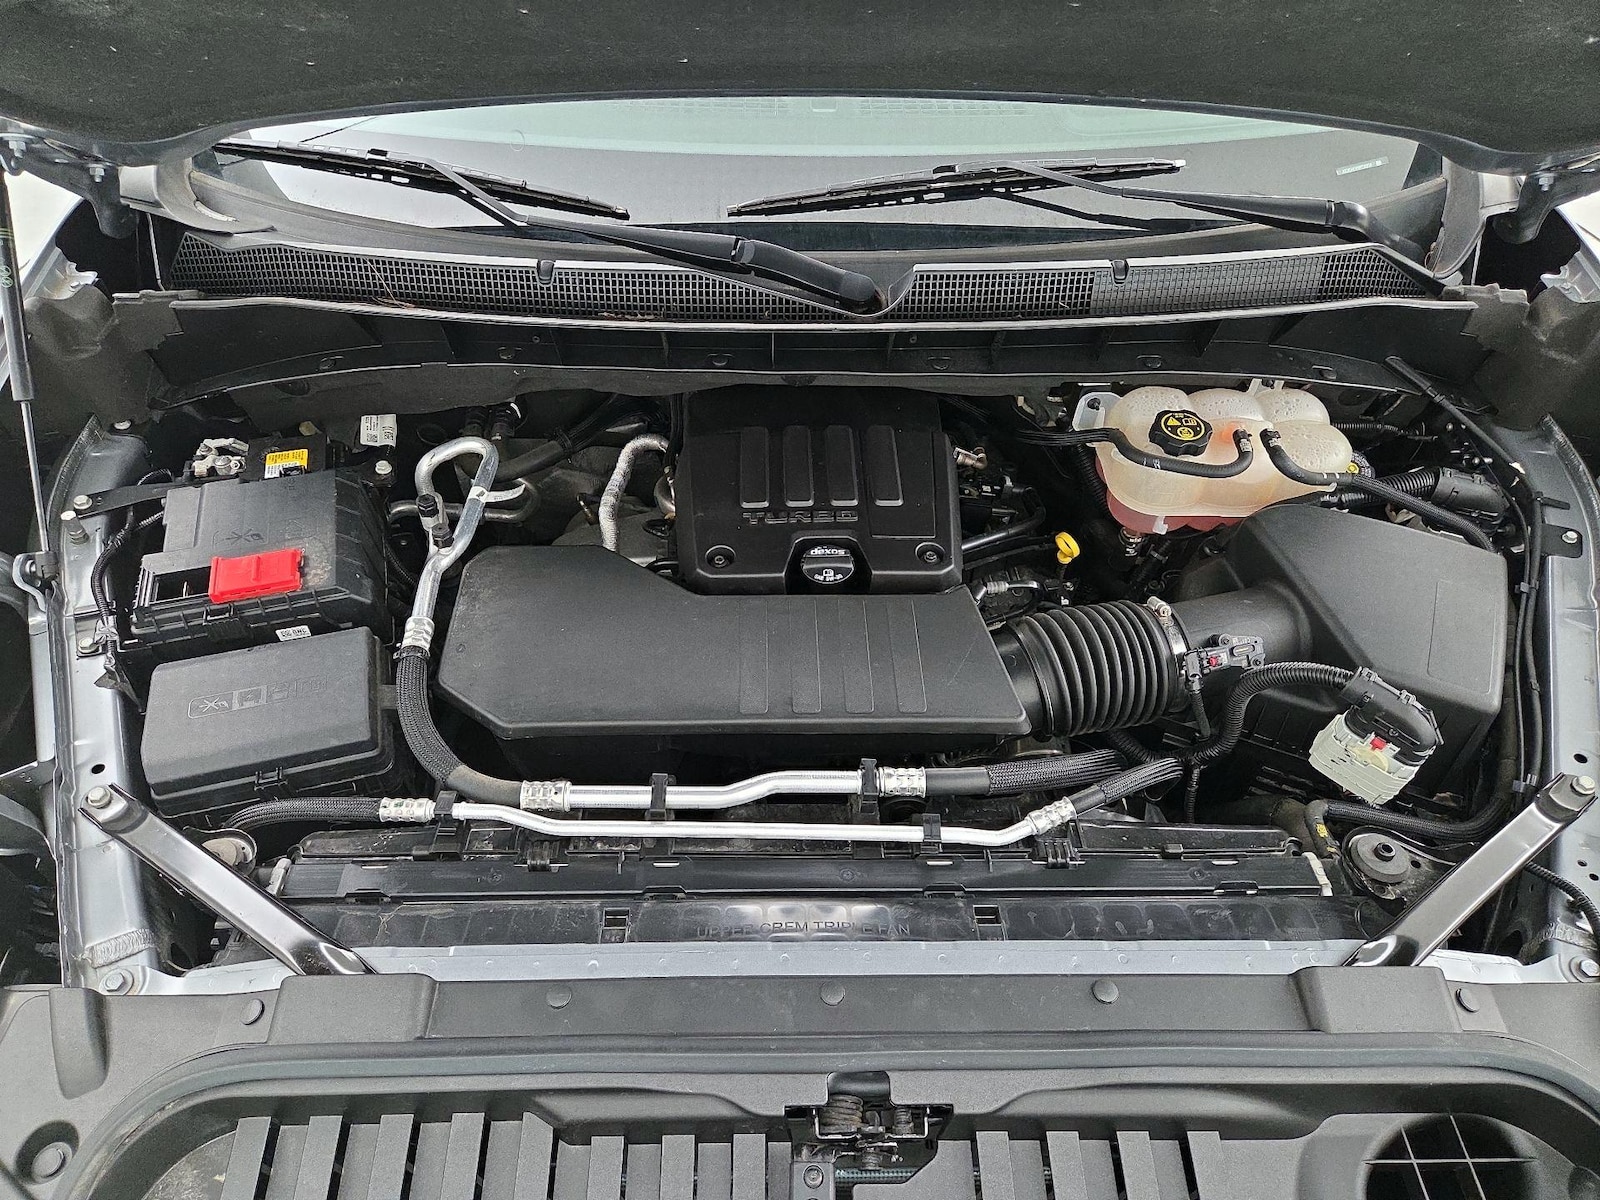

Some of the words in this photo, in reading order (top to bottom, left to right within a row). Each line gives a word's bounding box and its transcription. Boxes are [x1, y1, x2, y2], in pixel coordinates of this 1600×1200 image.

[742, 510, 859, 525] TURBO
[810, 547, 846, 555] dexos
[697, 923, 754, 938] UPPER
[878, 923, 910, 936] FAN
